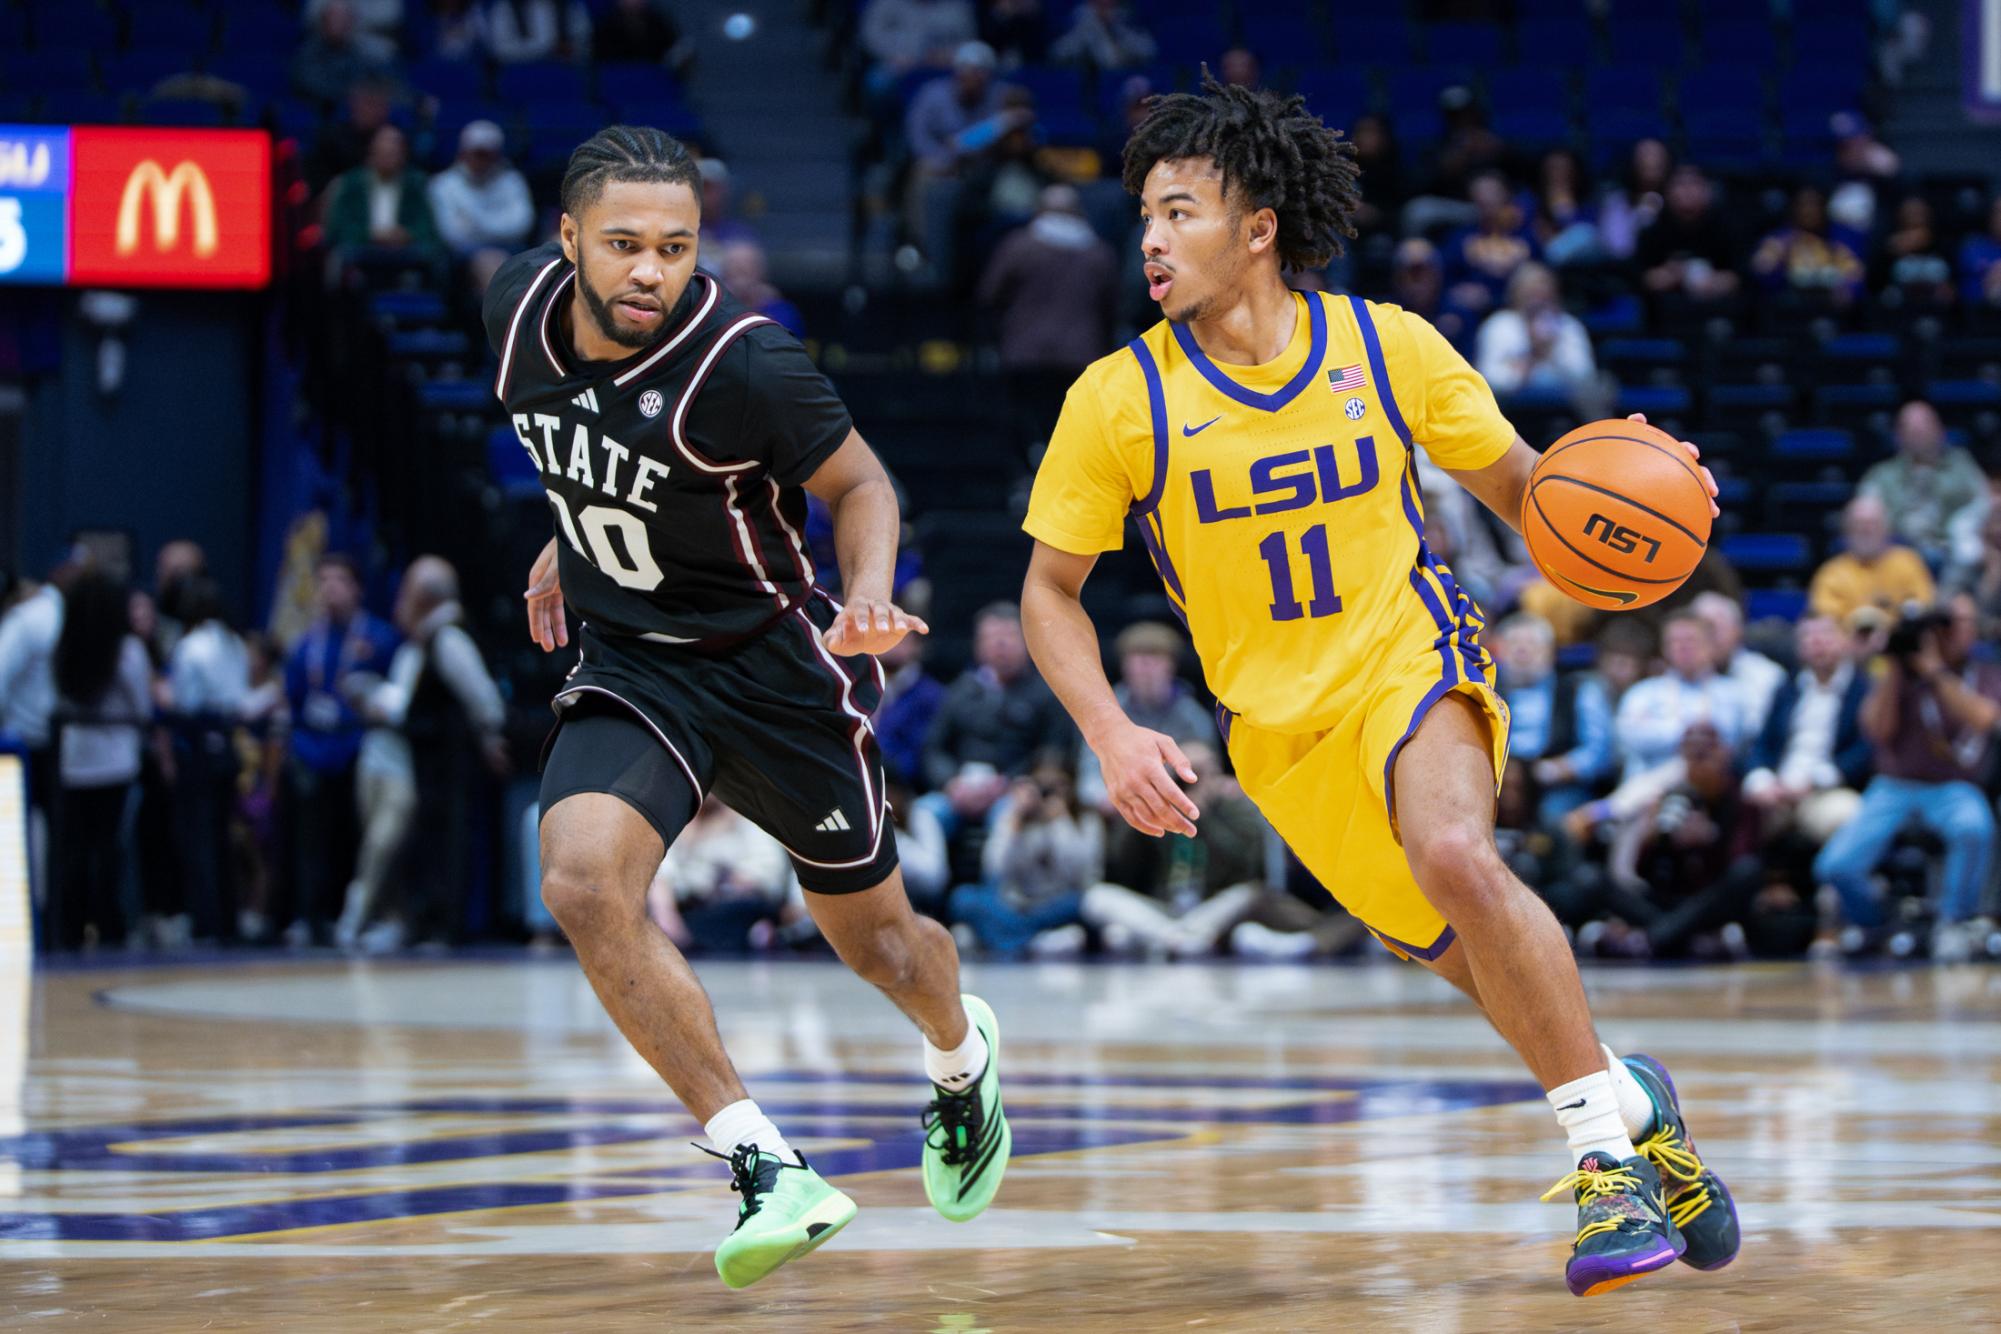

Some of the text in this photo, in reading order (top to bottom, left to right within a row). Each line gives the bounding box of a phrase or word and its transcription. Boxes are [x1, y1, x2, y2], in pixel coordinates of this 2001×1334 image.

[641, 392, 661, 415] SEC
[1345, 398, 1365, 420] SEC
[512, 413, 670, 513] STATE
[1190, 436, 1380, 524] LSU
[1259, 524, 1343, 621] 11
[1583, 513, 1663, 564] LSU
